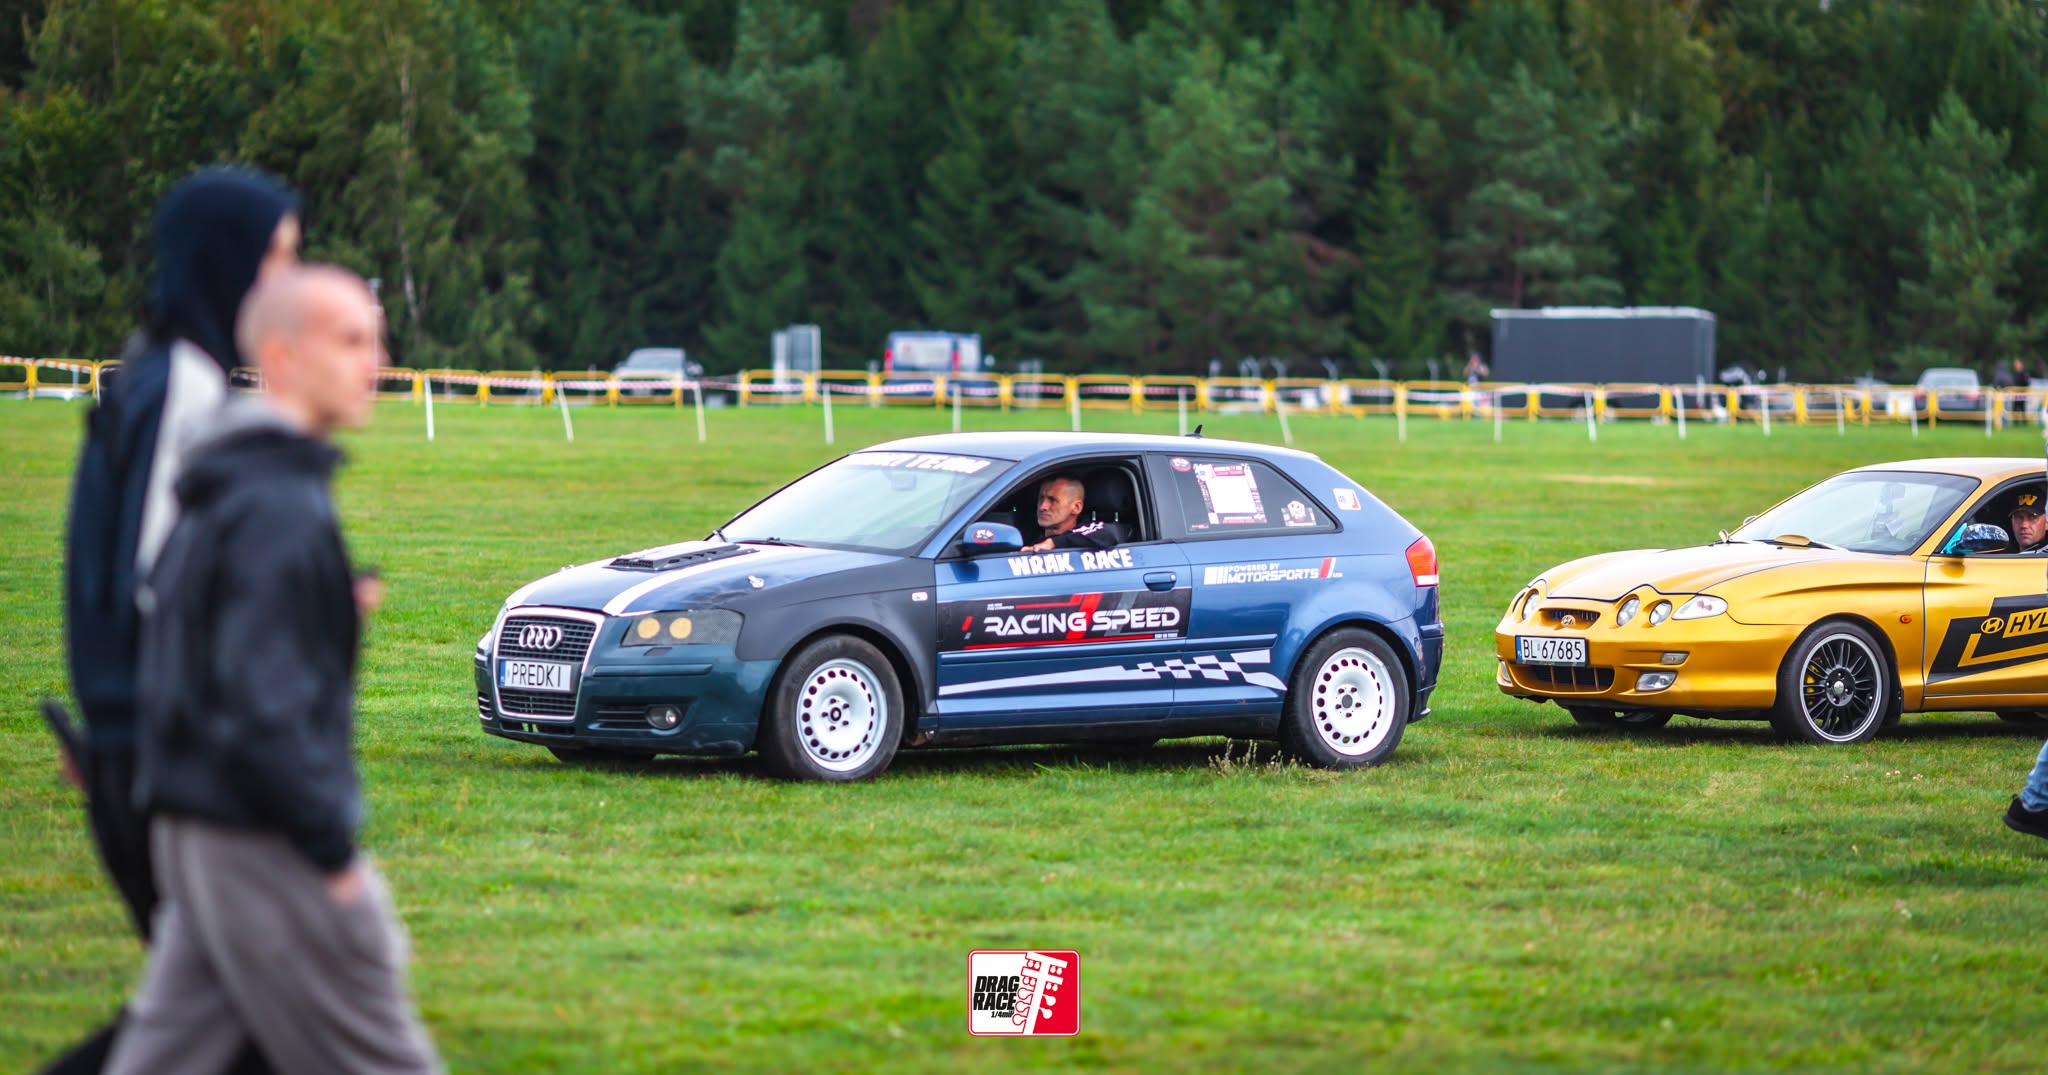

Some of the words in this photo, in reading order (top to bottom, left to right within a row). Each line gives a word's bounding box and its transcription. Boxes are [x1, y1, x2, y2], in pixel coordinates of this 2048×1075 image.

[1008, 552, 1074, 576] WRAK
[1081, 549, 1133, 570] RACE
[1228, 564, 1267, 573] POWERED
[1228, 568, 1319, 584] MOTORSPORTS
[983, 612, 1087, 636] RACING
[1091, 606, 1180, 631] SPEED
[1523, 639, 1537, 659] BL
[1541, 640, 1582, 660] 67685
[511, 663, 561, 687] PREDKI
